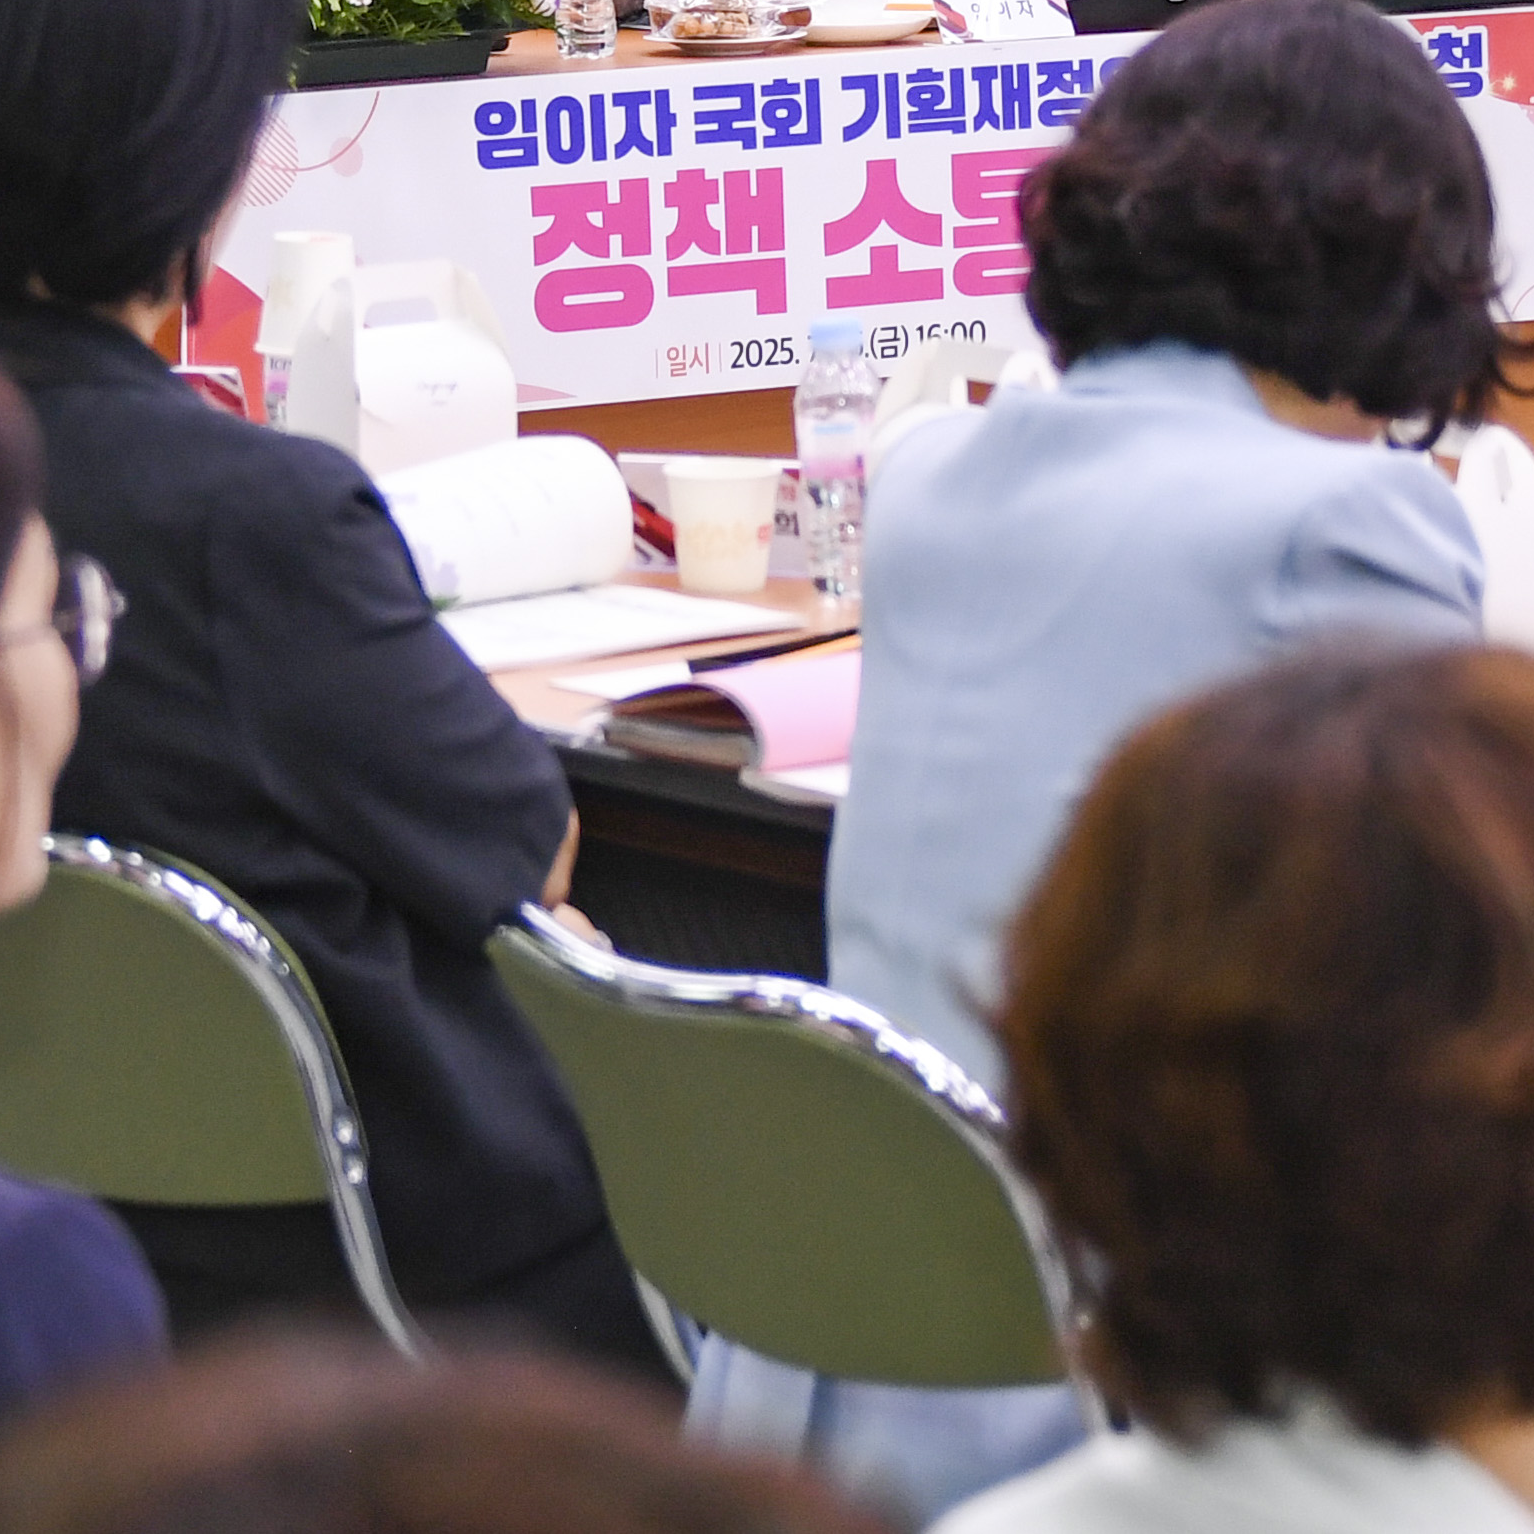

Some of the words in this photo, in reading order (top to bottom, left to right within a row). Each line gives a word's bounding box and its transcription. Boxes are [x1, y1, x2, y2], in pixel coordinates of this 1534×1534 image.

[473, 88, 678, 171] 임이자
[692, 76, 823, 152] 국회
[841, 56, 1133, 144] 기획재정
[1416, 32, 1485, 98] 청
[530, 166, 789, 334] 정책
[665, 342, 711, 378] 일시
[730, 336, 801, 370] 2025.
